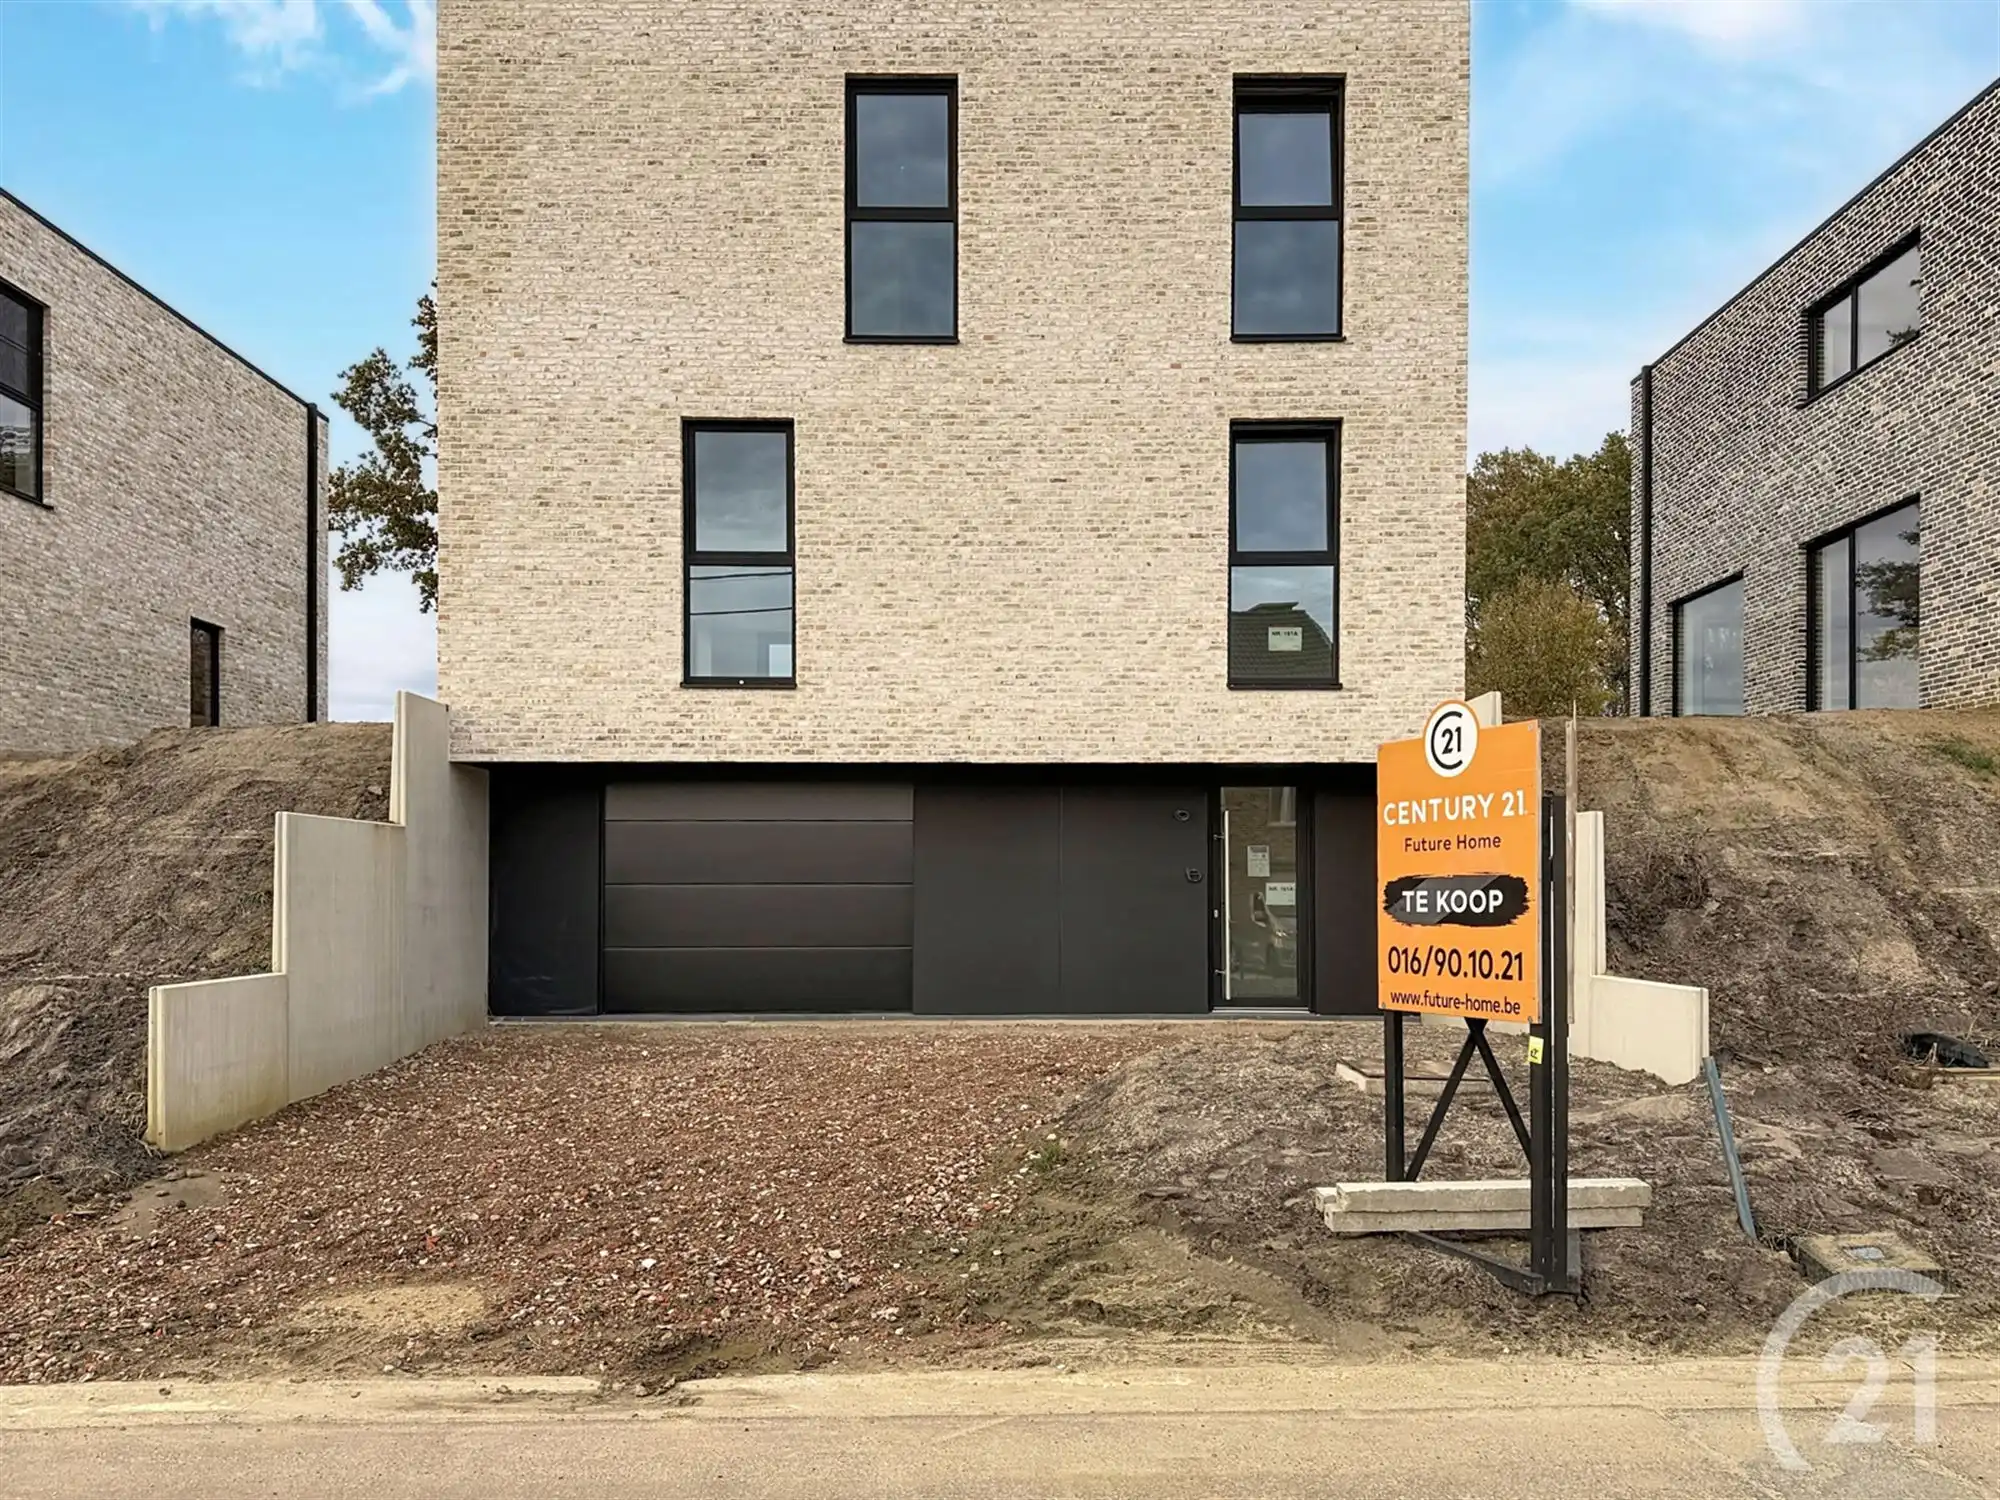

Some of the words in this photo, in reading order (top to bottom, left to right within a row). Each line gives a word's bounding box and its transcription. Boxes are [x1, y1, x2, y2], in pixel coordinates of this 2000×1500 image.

[1441, 726, 1461, 755] 21
[1383, 791, 1495, 826] CENTURY
[1502, 789, 1525, 817] 21
[1404, 837, 1451, 853] Future
[1457, 834, 1501, 850] Home
[1402, 890, 1428, 913] TE
[1436, 889, 1504, 913] KOOP
[1388, 945, 1523, 981] 016/90.10.21
[1390, 989, 1521, 1015] www.future-home.be
